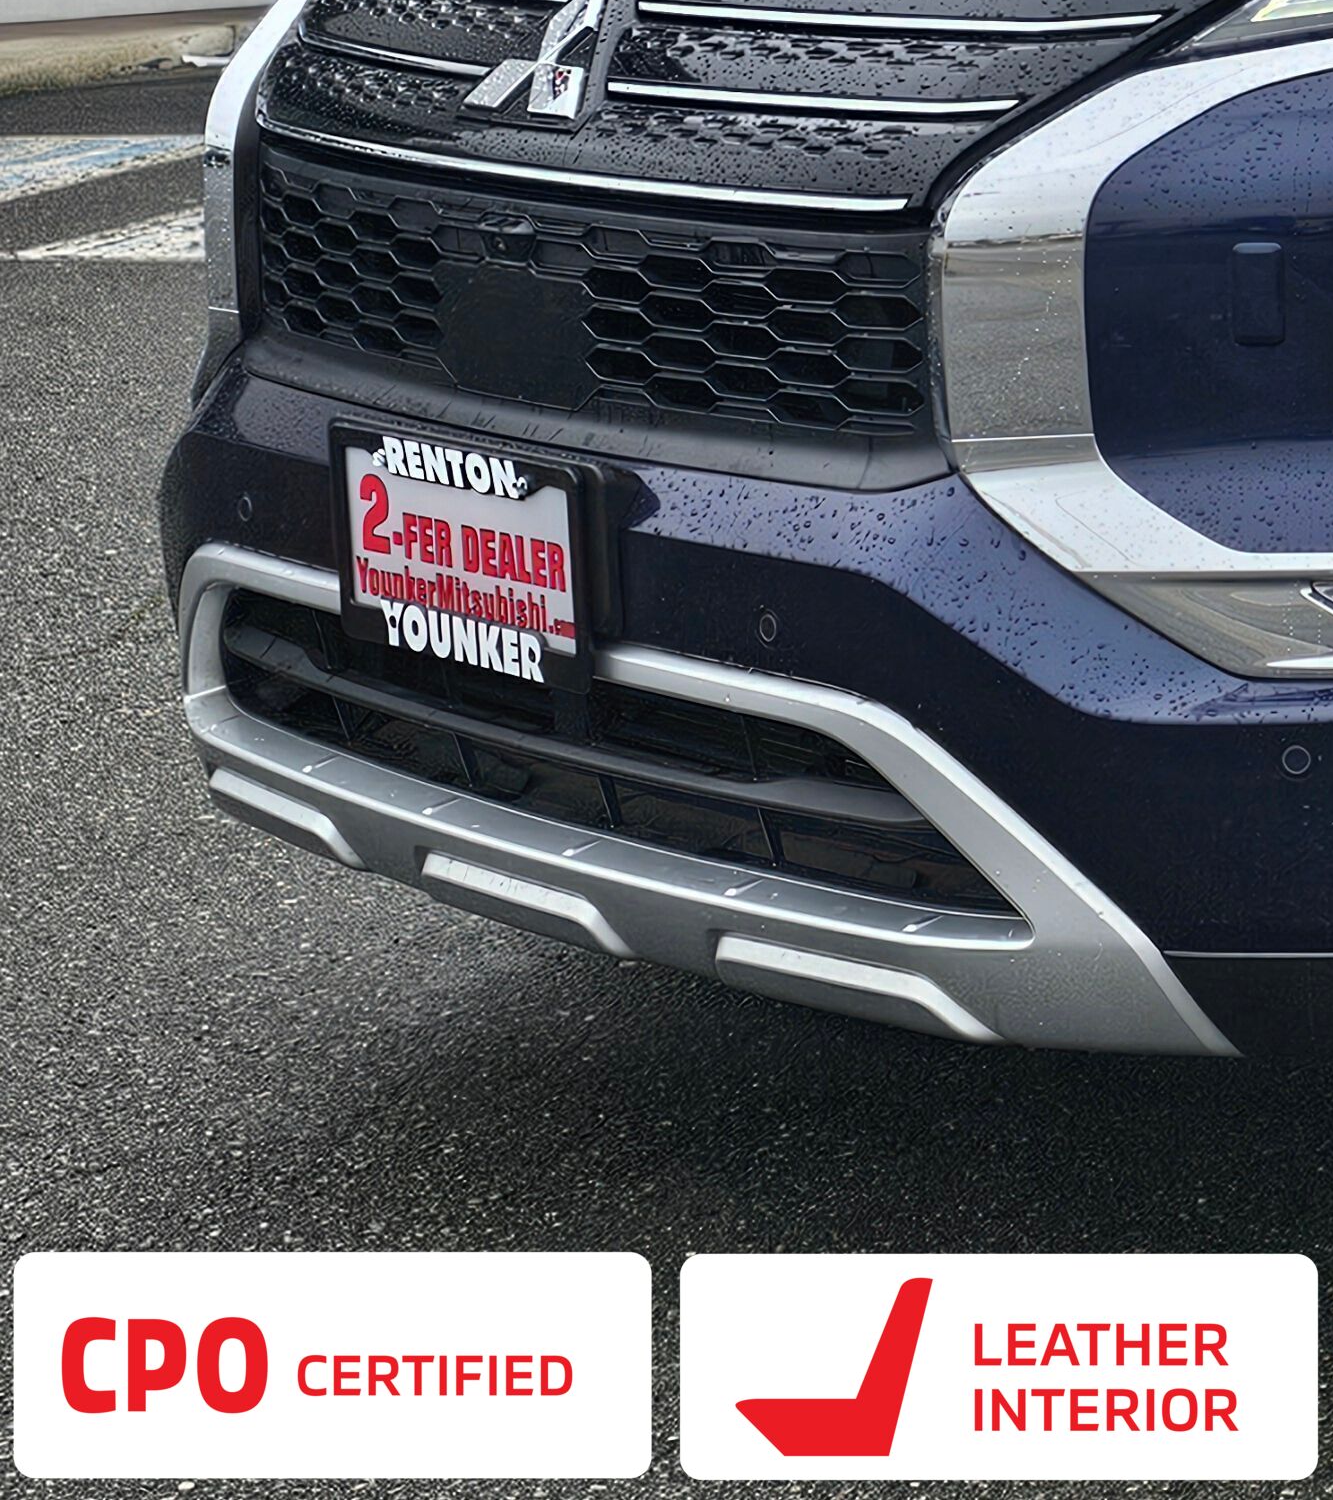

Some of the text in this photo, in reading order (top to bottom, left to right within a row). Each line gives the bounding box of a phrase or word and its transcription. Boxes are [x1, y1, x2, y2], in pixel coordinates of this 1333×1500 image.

[382, 435, 520, 499] RENTON
[460, 524, 567, 592] DEALER
[380, 599, 545, 683] YOUNKER
